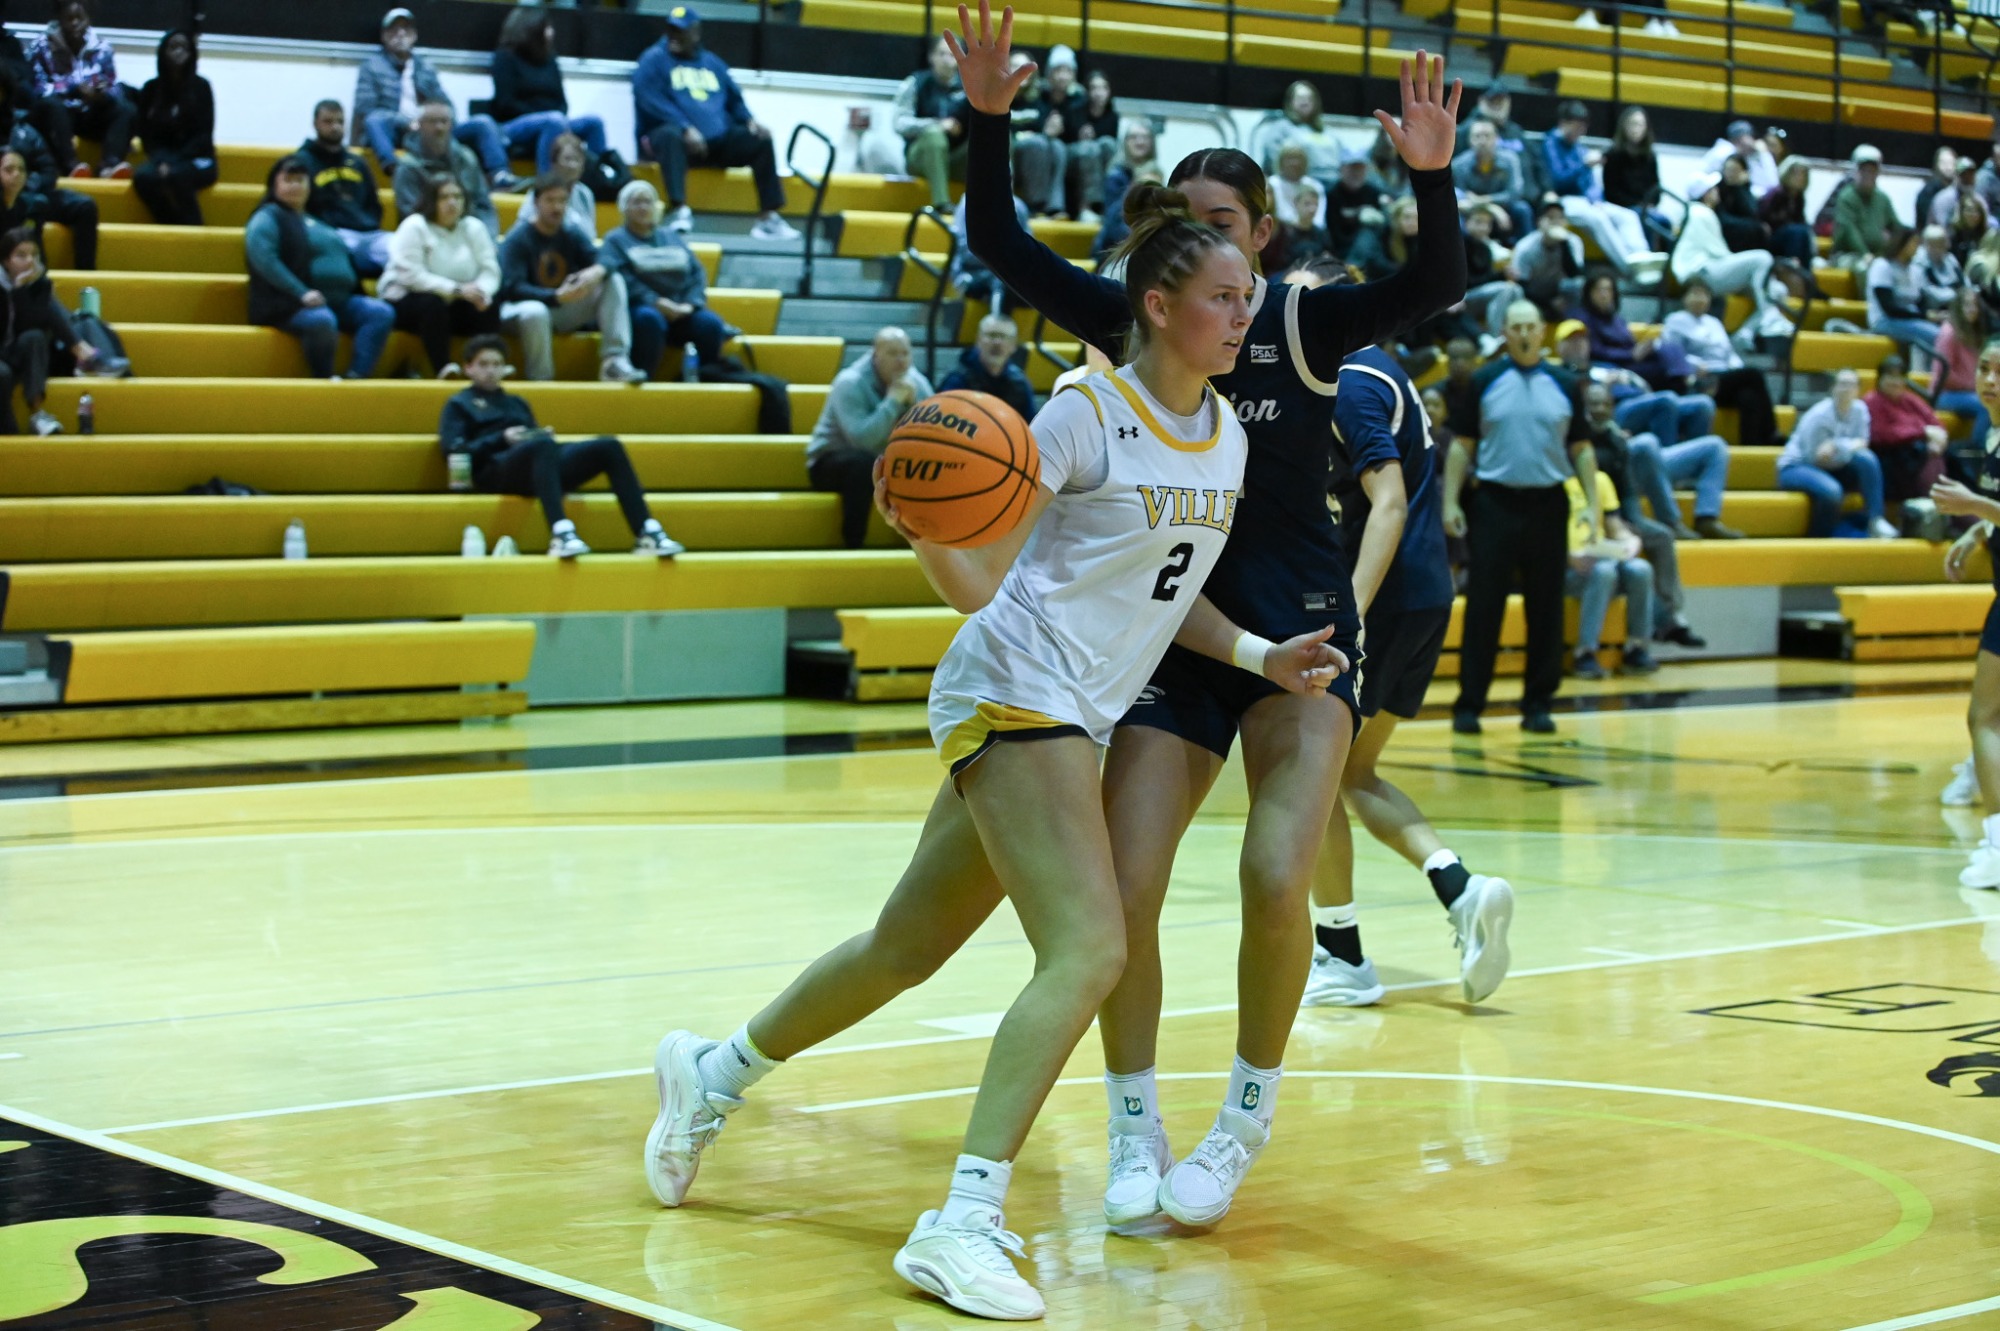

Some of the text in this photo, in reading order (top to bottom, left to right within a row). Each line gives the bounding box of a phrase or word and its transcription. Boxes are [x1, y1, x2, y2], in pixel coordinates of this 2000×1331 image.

[1250, 348, 1279, 358] PSAC
[891, 457, 944, 482] EVO
[1137, 485, 1236, 536] VILLE
[1151, 542, 1194, 602] 2
[1329, 597, 1337, 606] M
